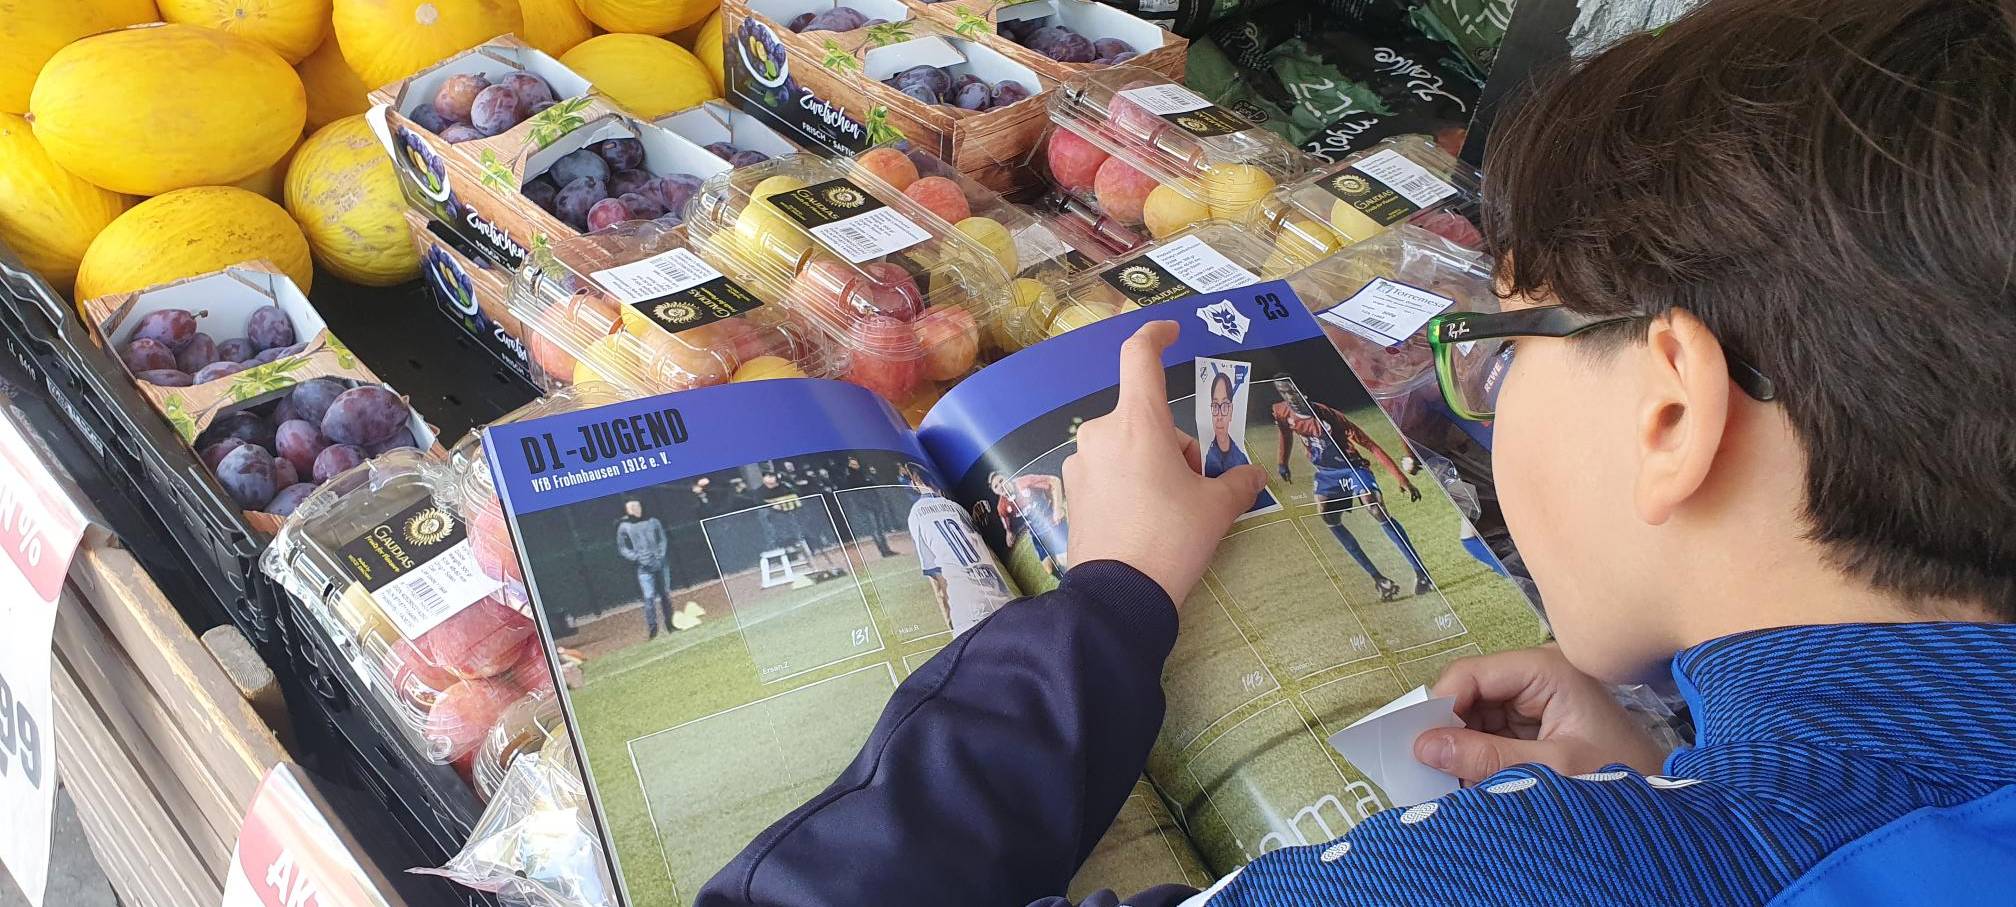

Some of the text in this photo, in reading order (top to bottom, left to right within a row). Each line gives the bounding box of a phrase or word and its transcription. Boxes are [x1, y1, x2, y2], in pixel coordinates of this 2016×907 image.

[799, 86, 864, 140] Zwetschen
[801, 121, 826, 142] FRISCH
[796, 189, 840, 219] GAUDIAS
[465, 203, 525, 261] Zwetschen
[688, 289, 731, 318] GAUDIAS
[1137, 284, 1186, 307] GAUDIAS
[1254, 292, 1290, 321] 23
[1393, 286, 1446, 308] Torremesa
[1484, 361, 1503, 393] REWE
[520, 408, 689, 475] D1-JUGEND
[531, 451, 672, 493] VfB Frohnhausen 1912 e. V.
[1338, 477, 1358, 492] 142
[373, 524, 416, 569] GAUDIAS
[934, 518, 981, 568] 10
[851, 626, 870, 648] 131
[1433, 613, 1452, 632] 145
[1349, 633, 1367, 652] 144
[1241, 670, 1264, 693] 143
